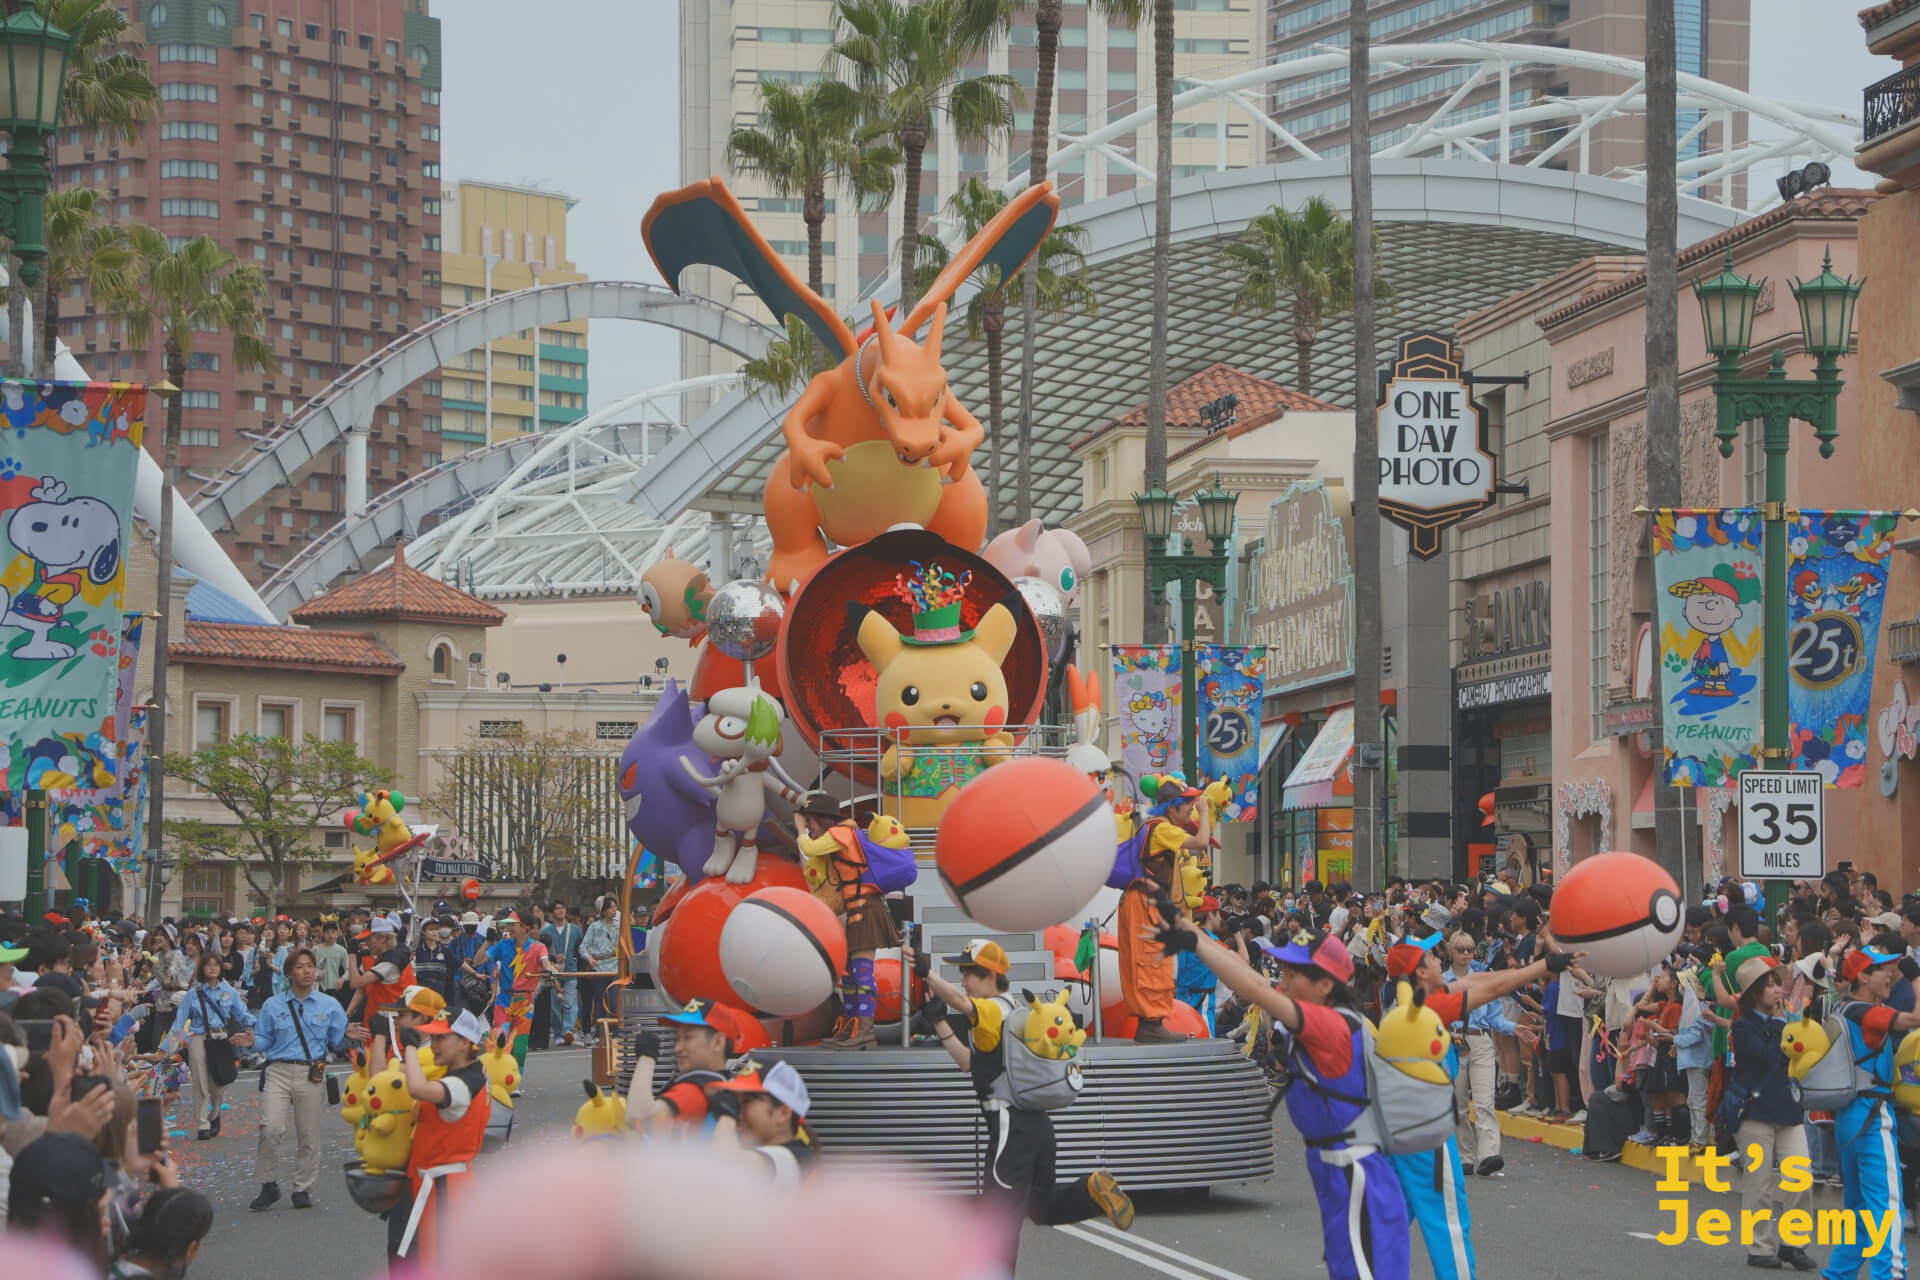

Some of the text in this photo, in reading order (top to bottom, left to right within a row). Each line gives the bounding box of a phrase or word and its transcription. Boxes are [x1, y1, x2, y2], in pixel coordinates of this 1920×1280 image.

[1394, 390, 1460, 418] ONE
[1398, 424, 1458, 453] DAY
[1378, 457, 1480, 486] PHOTO
[1494, 580, 1550, 652] DARKR
[1789, 621, 1867, 676] 25th
[1494, 673, 1548, 702] PHOTOGRAPHIC
[1675, 723, 1753, 741] PEANUTS
[1744, 778, 1818, 794] SPEED LIMIT
[1748, 802, 1818, 845] 35
[1763, 852, 1801, 868] MILES
